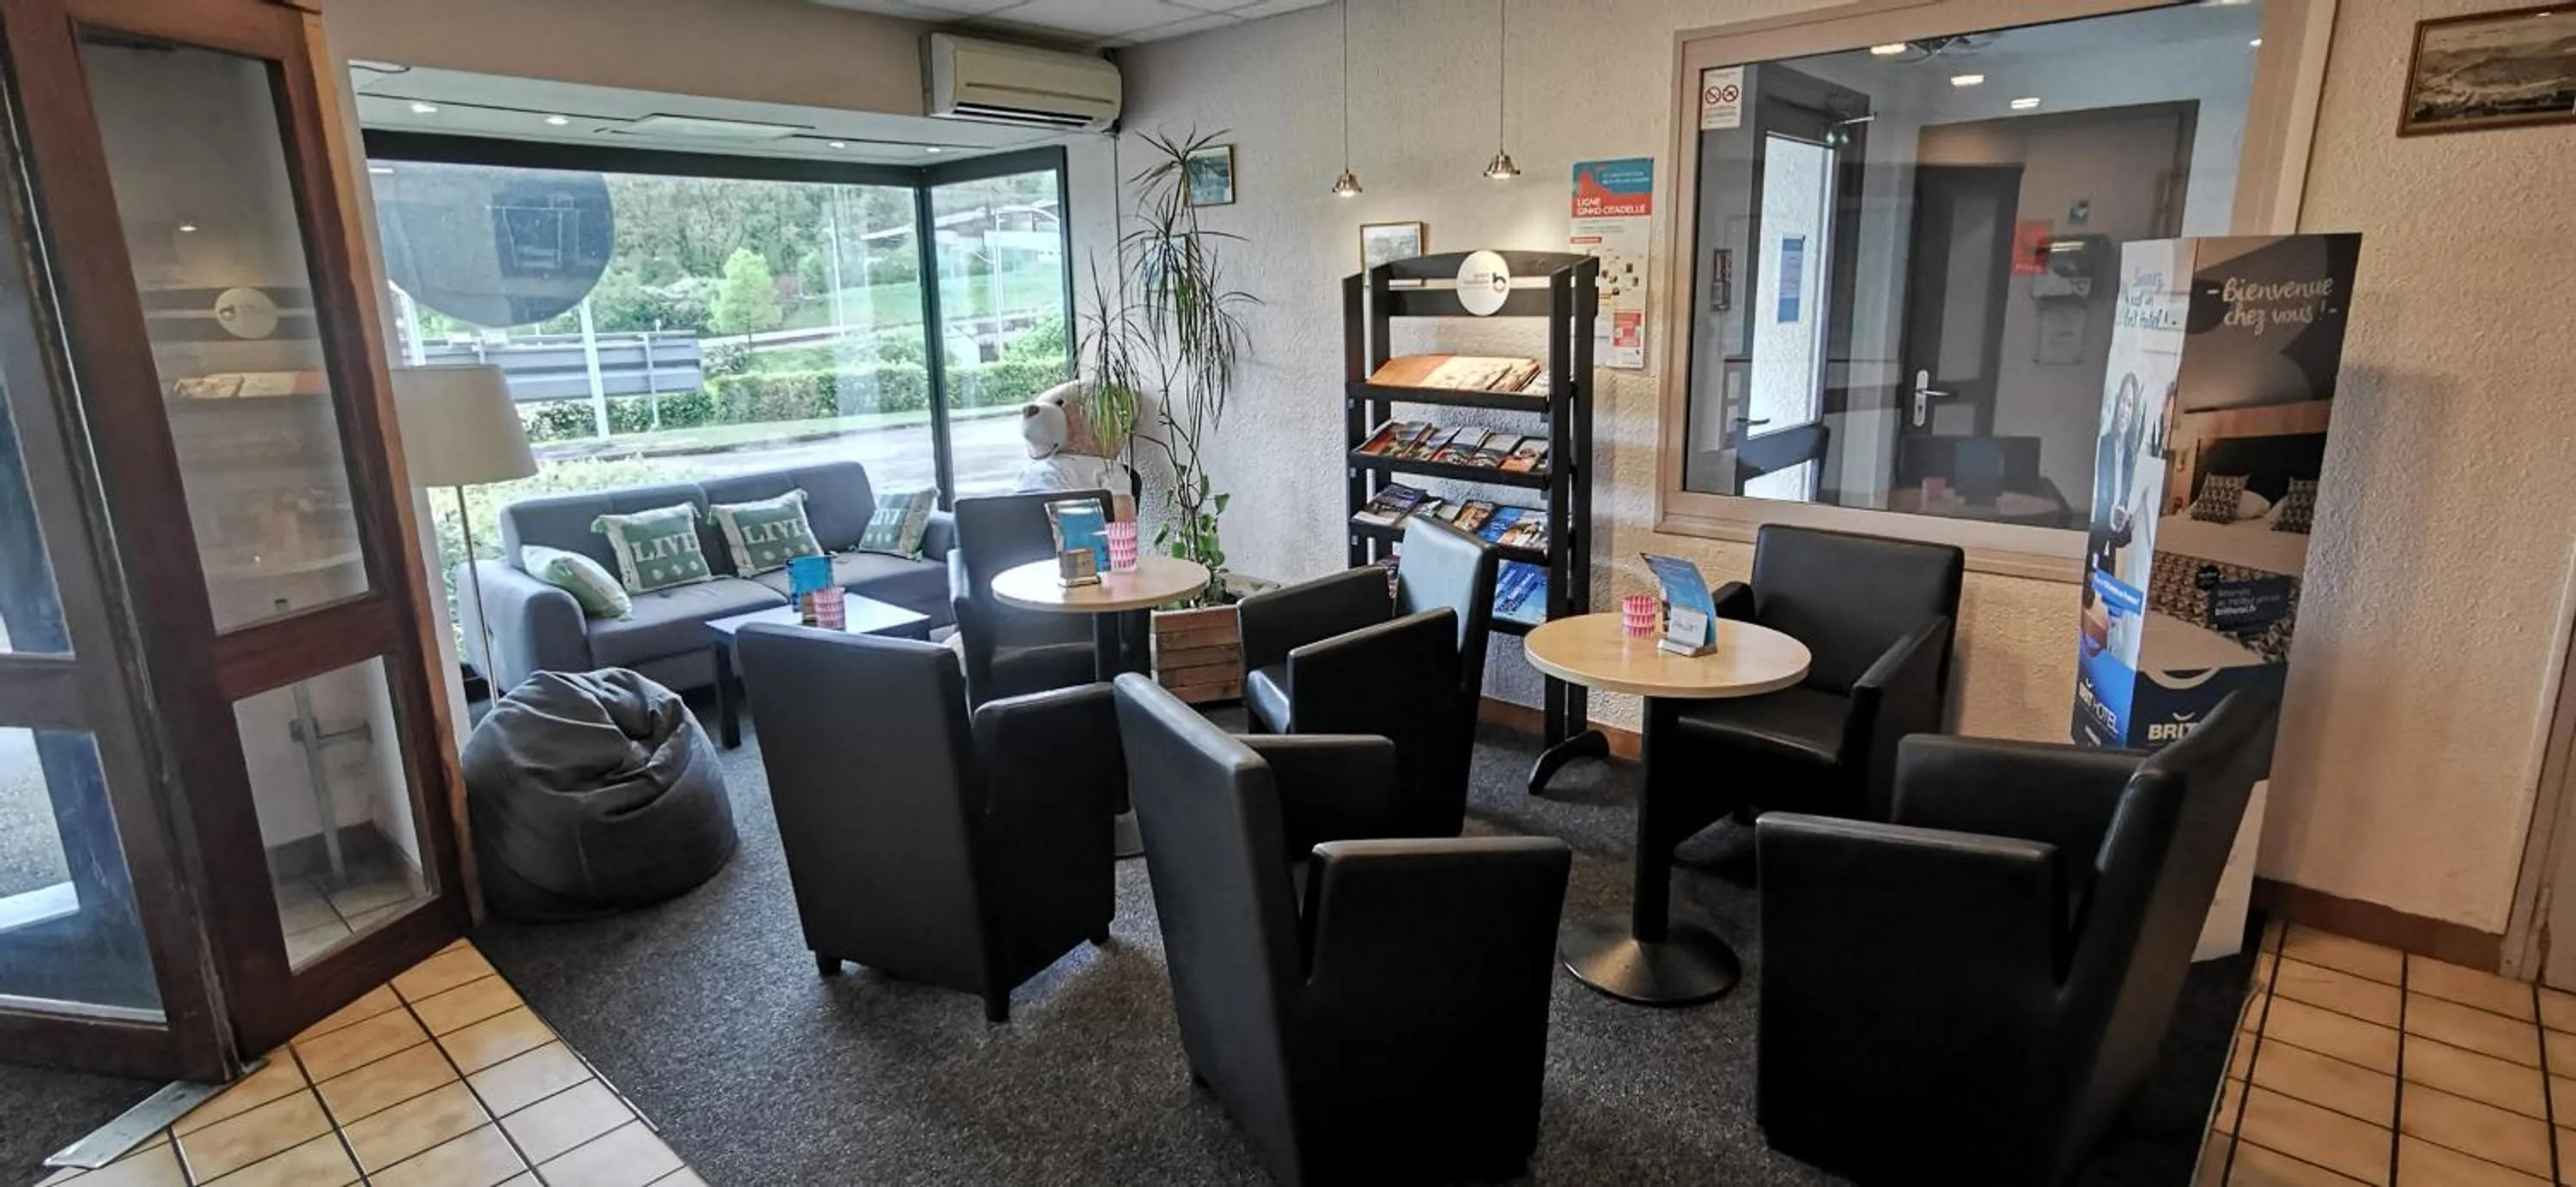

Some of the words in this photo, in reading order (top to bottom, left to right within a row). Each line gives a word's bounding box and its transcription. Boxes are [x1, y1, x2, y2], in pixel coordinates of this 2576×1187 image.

[1577, 197, 1601, 207] LIGNE
[2222, 276, 2334, 302] Bienvenue
[2224, 301, 2267, 336] chez
[631, 532, 700, 563] LIVE
[2148, 722, 2200, 740] BRIT
